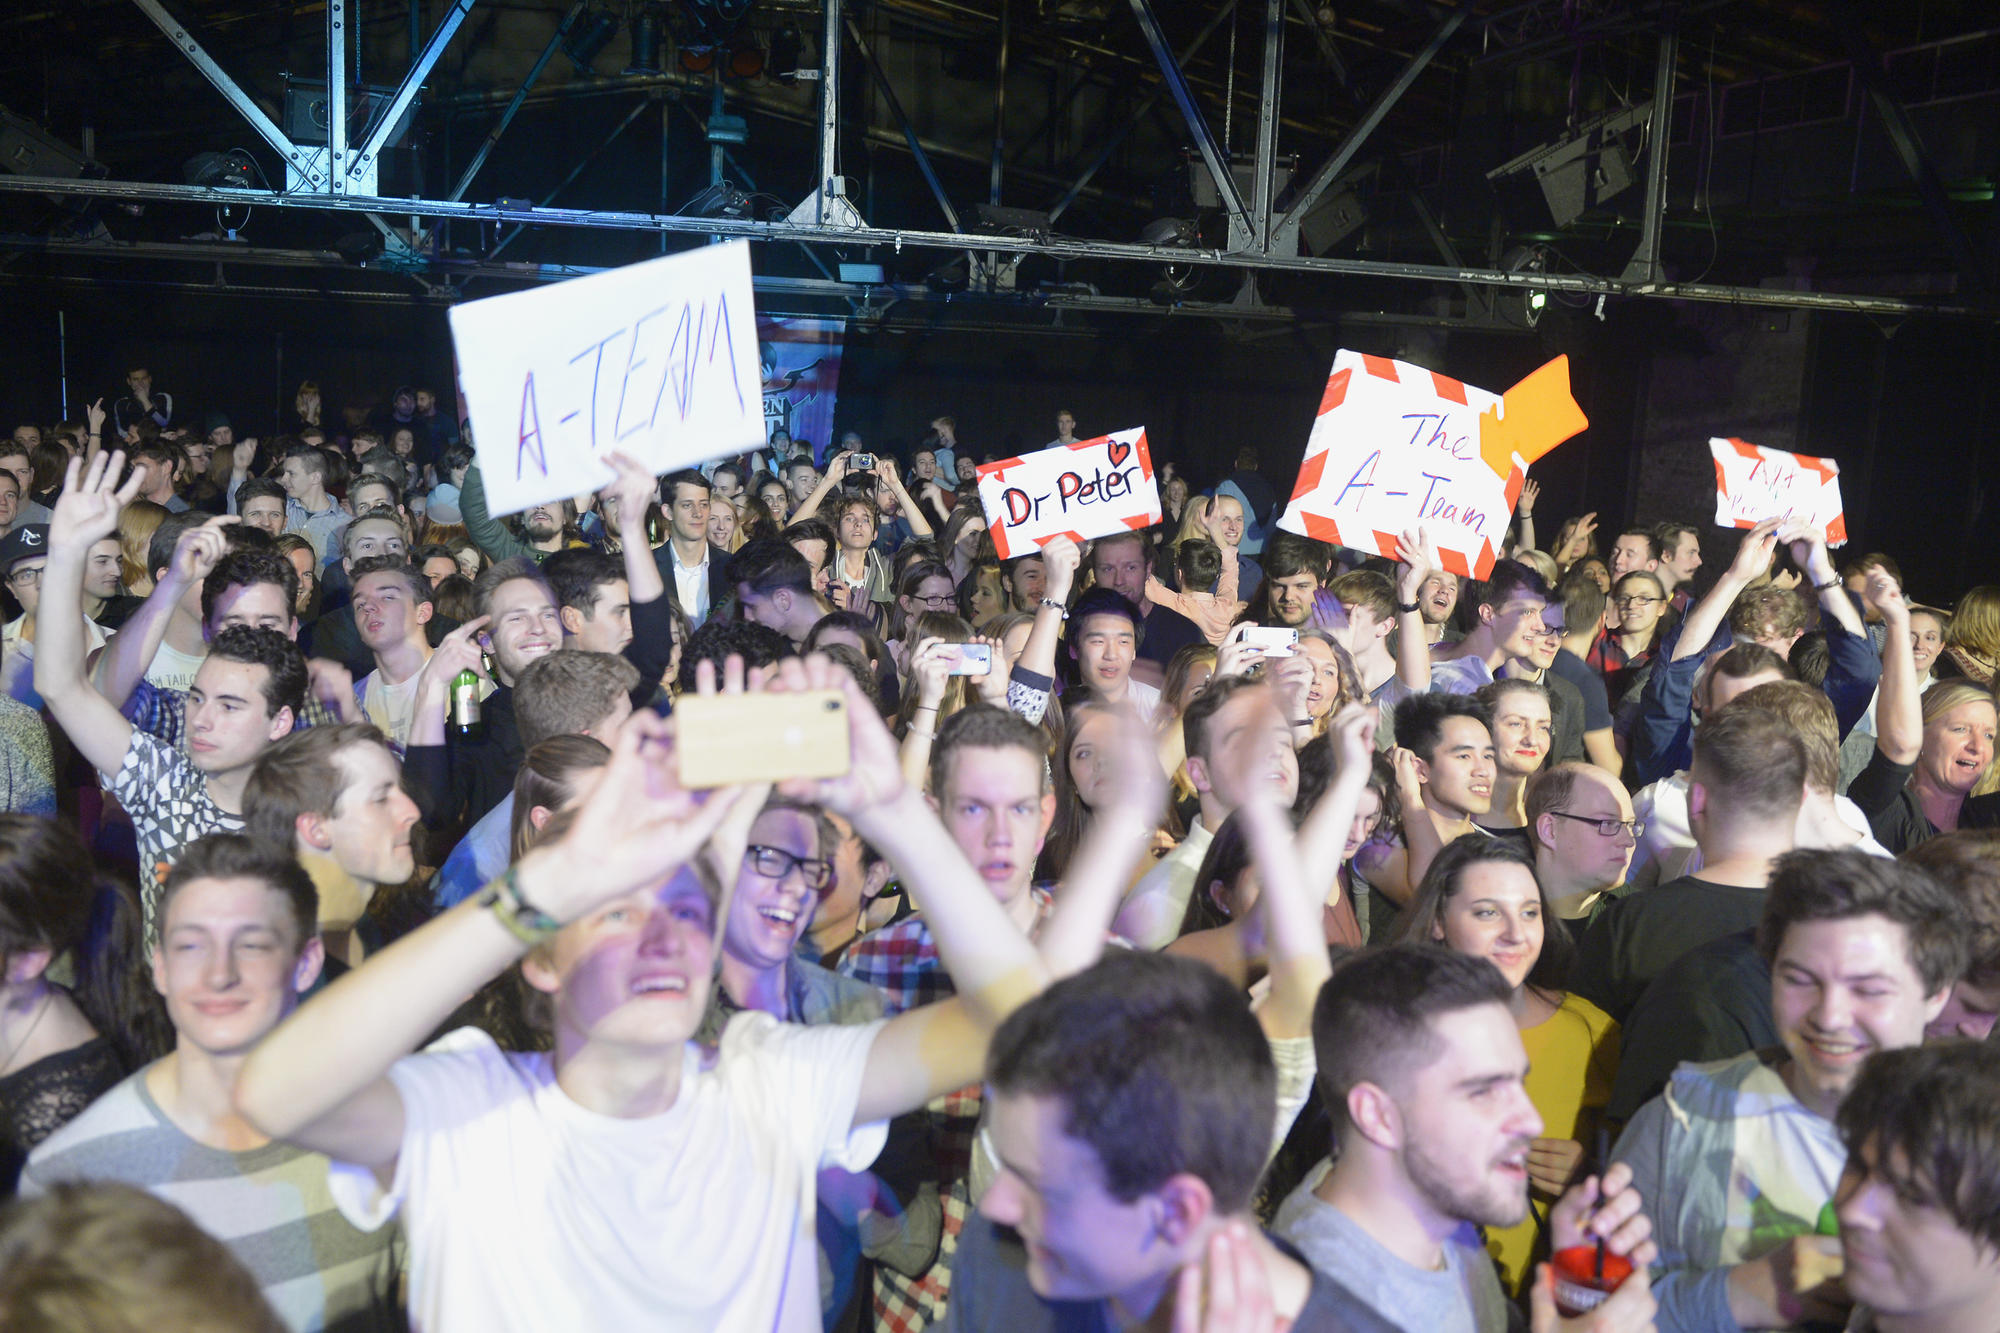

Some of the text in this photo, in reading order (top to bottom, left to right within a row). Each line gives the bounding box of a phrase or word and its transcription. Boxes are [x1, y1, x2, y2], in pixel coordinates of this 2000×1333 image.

[516, 288, 745, 481] A-TEAM
[1402, 412, 1473, 461] The
[1001, 466, 1141, 528] Dr Peter
